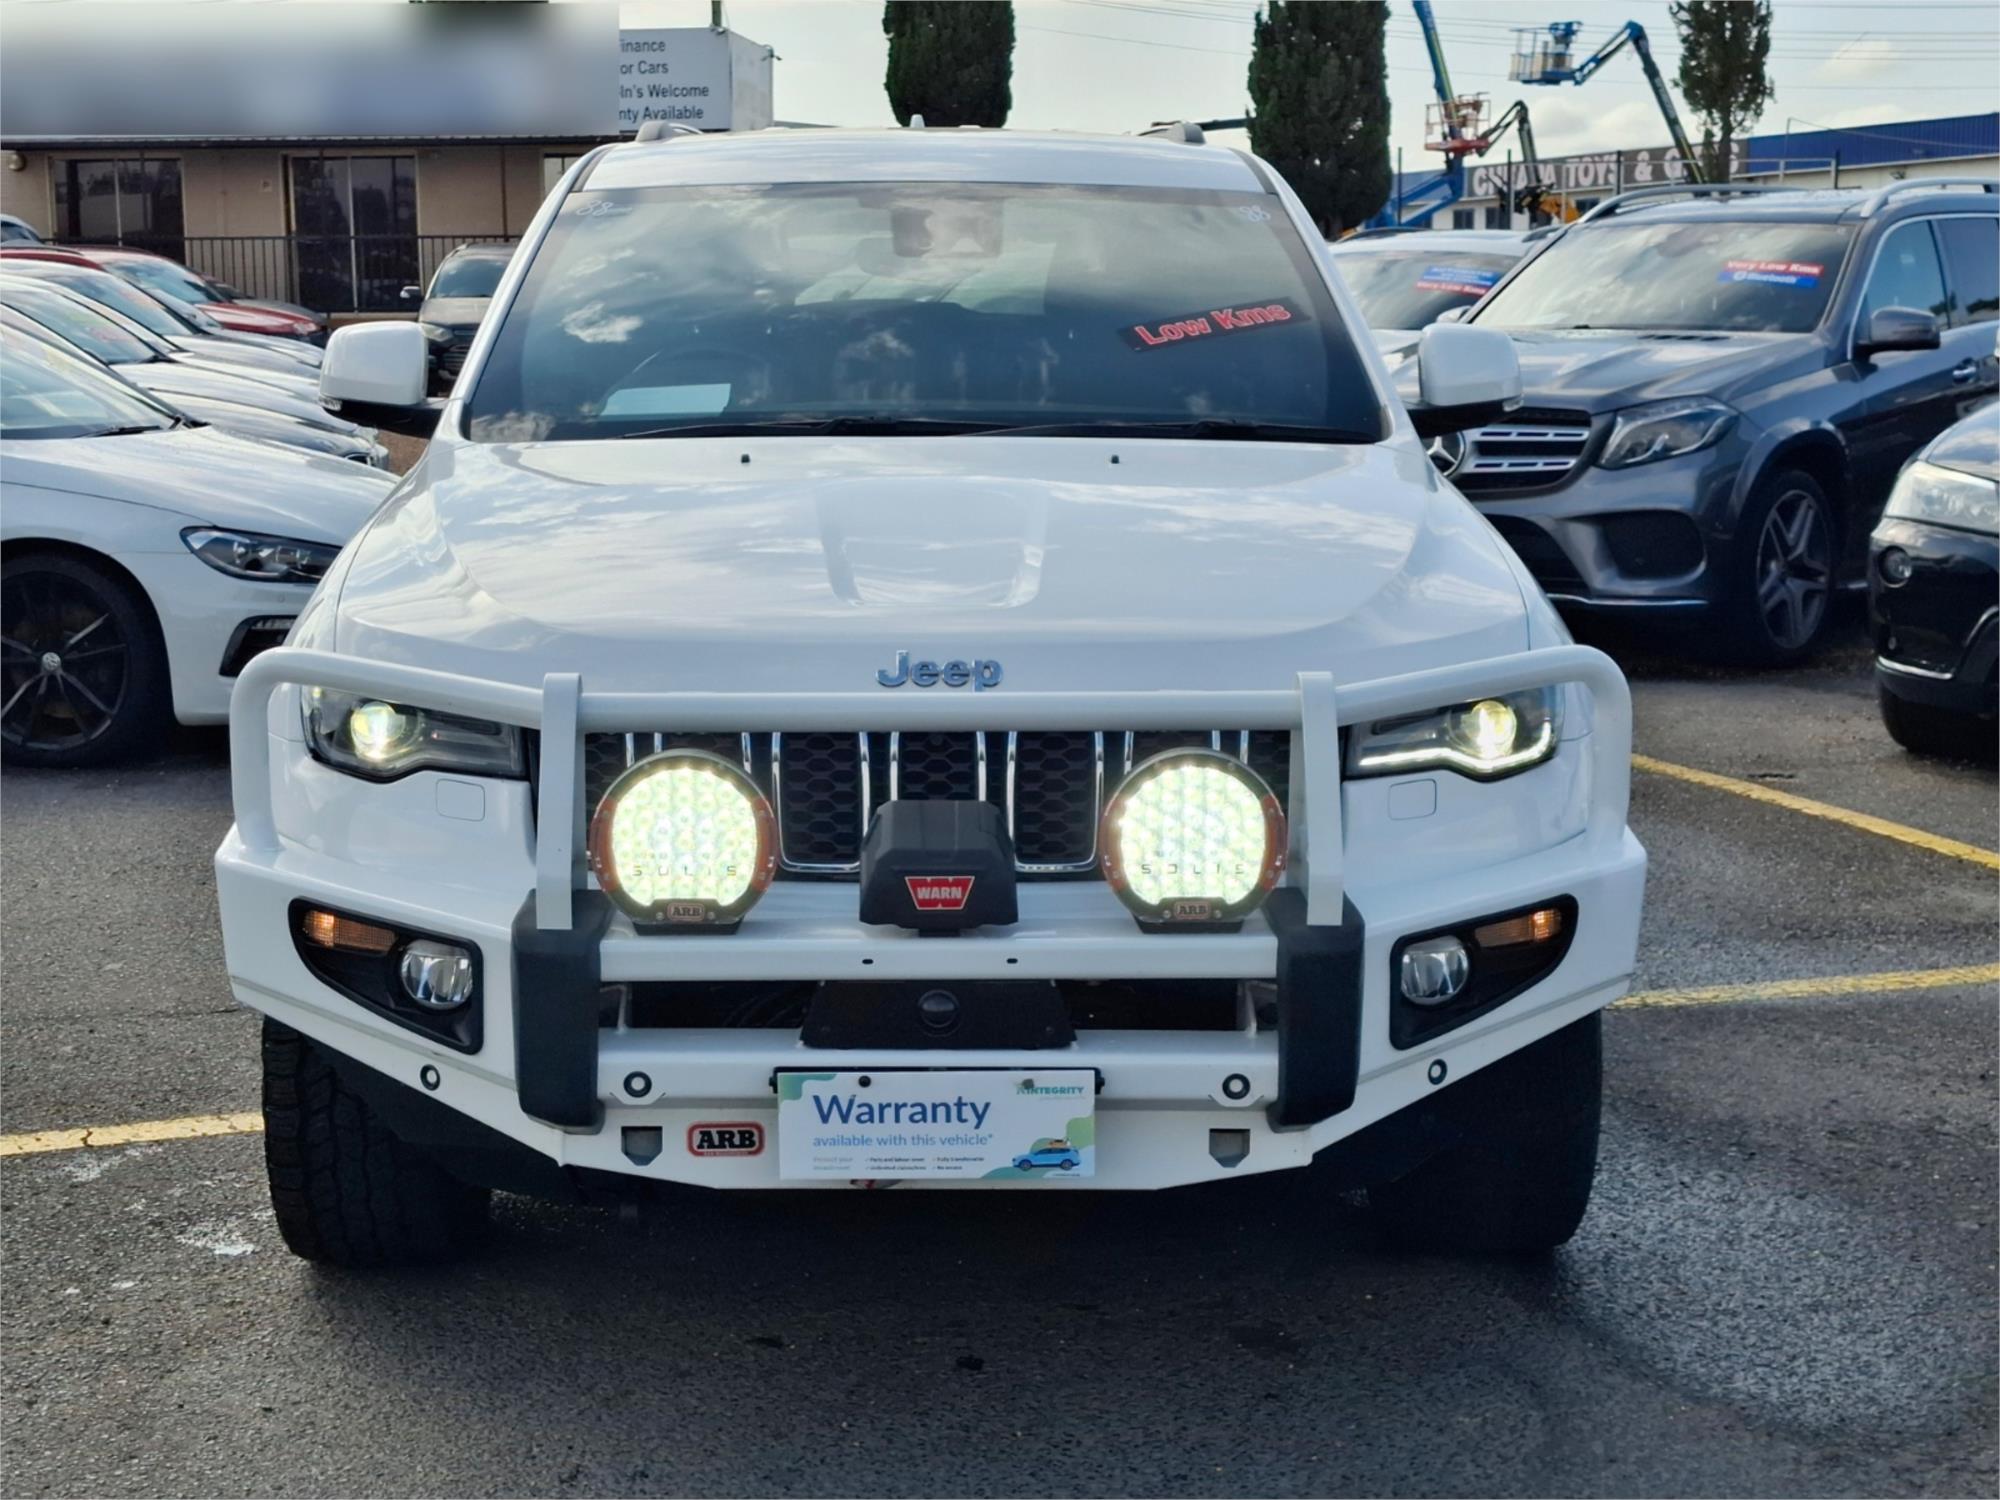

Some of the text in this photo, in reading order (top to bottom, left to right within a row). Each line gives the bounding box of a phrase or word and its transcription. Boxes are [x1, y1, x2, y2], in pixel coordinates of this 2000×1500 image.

[638, 60, 669, 75] Cars
[648, 83, 710, 98] Welcome
[643, 105, 704, 120] Available
[1566, 155, 1625, 188] TOYS
[1634, 151, 1654, 182] &
[1134, 304, 1292, 346] Low Kms
[875, 650, 1004, 693] Jeep
[917, 886, 963, 900] WARN
[672, 905, 703, 918] ARB
[1178, 904, 1208, 916] ARB
[812, 1094, 992, 1130] Warranty
[696, 1129, 757, 1150] ARB
[812, 1133, 873, 1147] available
[876, 1133, 908, 1147] with
[911, 1132, 936, 1147] this
